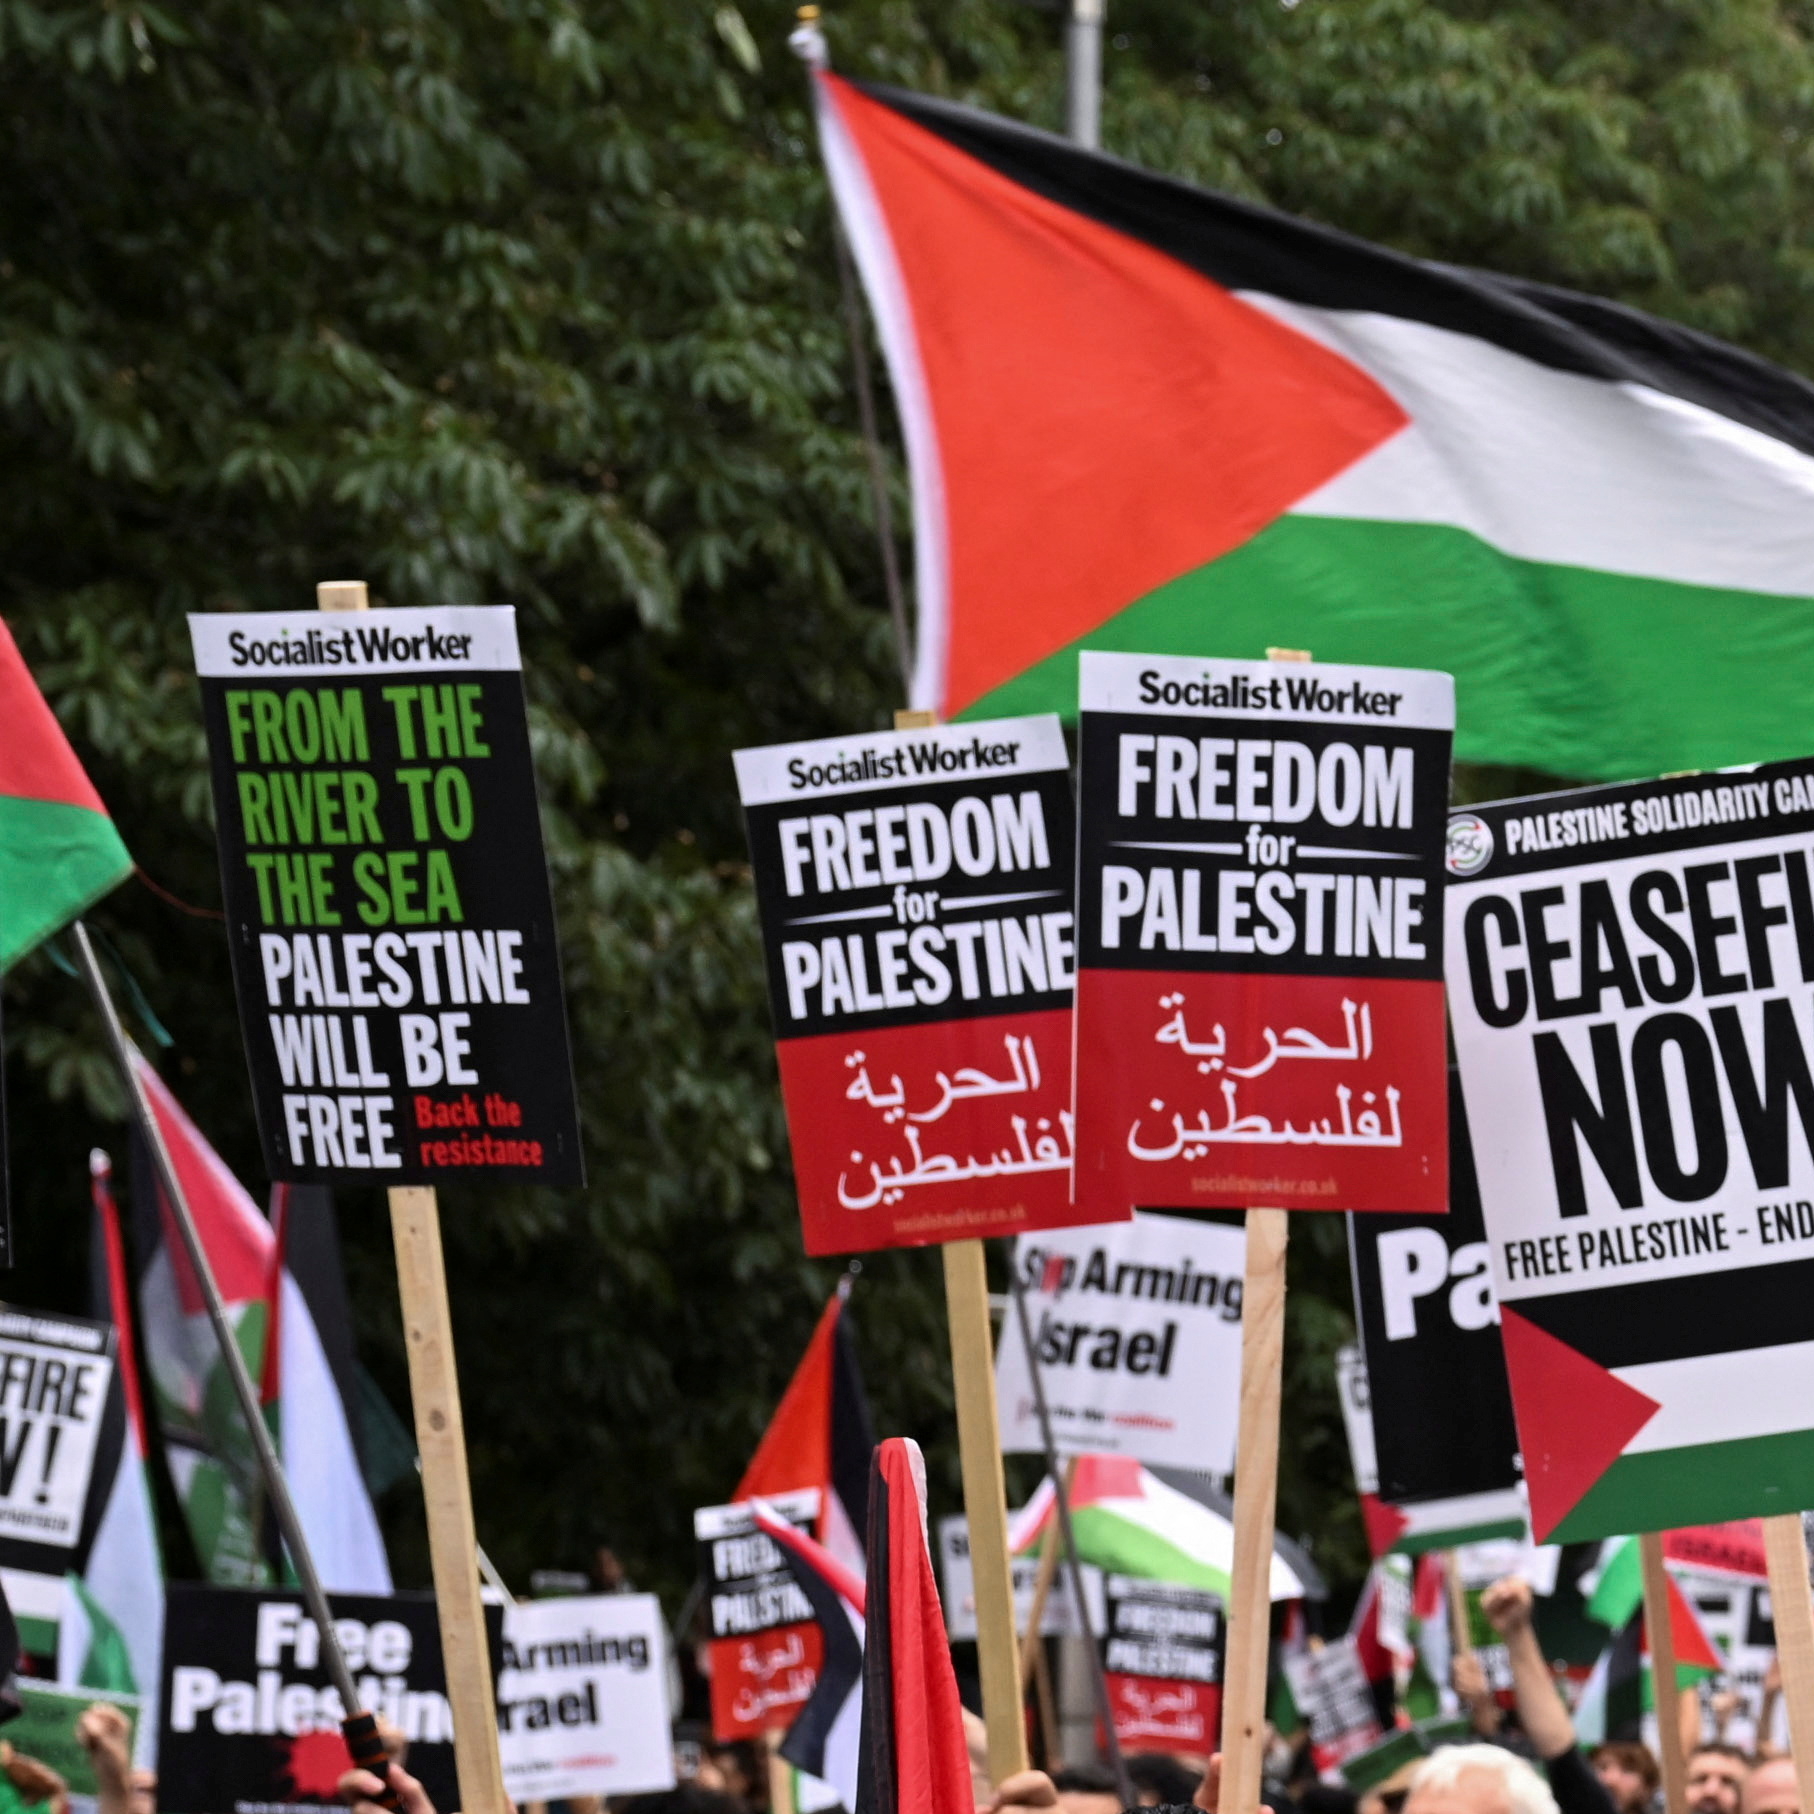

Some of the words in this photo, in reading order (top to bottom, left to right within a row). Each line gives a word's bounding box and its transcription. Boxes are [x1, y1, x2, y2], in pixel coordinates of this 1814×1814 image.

[229, 626, 357, 668] Socialist
[357, 628, 473, 664] Worker
[225, 688, 370, 766] FROM
[382, 684, 491, 760] THE
[1138, 669, 1282, 713] Socialist
[1285, 678, 1404, 720] Worker
[787, 748, 906, 790] Socialist
[914, 737, 1021, 776] Worker
[1117, 732, 1415, 830] FREEDOM
[236, 771, 384, 847] RIVER
[395, 766, 475, 842] TO
[778, 791, 1052, 898] FREEDOM
[1504, 801, 1630, 857] PALESTINE
[1630, 783, 1771, 834] SOLIDARITY
[1245, 824, 1297, 868] for
[246, 852, 342, 929] THE
[353, 849, 465, 925] SEA
[892, 885, 941, 924] for
[1100, 865, 1427, 962] PALESTINE
[259, 929, 531, 1007] PALESTINE
[781, 910, 1075, 1021] PALESTINE
[271, 1013, 389, 1090] WILL
[400, 1012, 479, 1088] BE
[1156, 991, 1374, 1079] الحرية
[844, 1035, 1041, 1125] الحرية
[283, 1096, 403, 1171] FREE
[414, 1097, 479, 1130] Back
[487, 1097, 521, 1127] the
[420, 1134, 543, 1168] resistance
[1127, 1079, 1404, 1161] لفلسطين
[1081, 1246, 1243, 1323] Arming
[1504, 1236, 1573, 1283] FREE
[1580, 1214, 1731, 1273] PALESTINE
